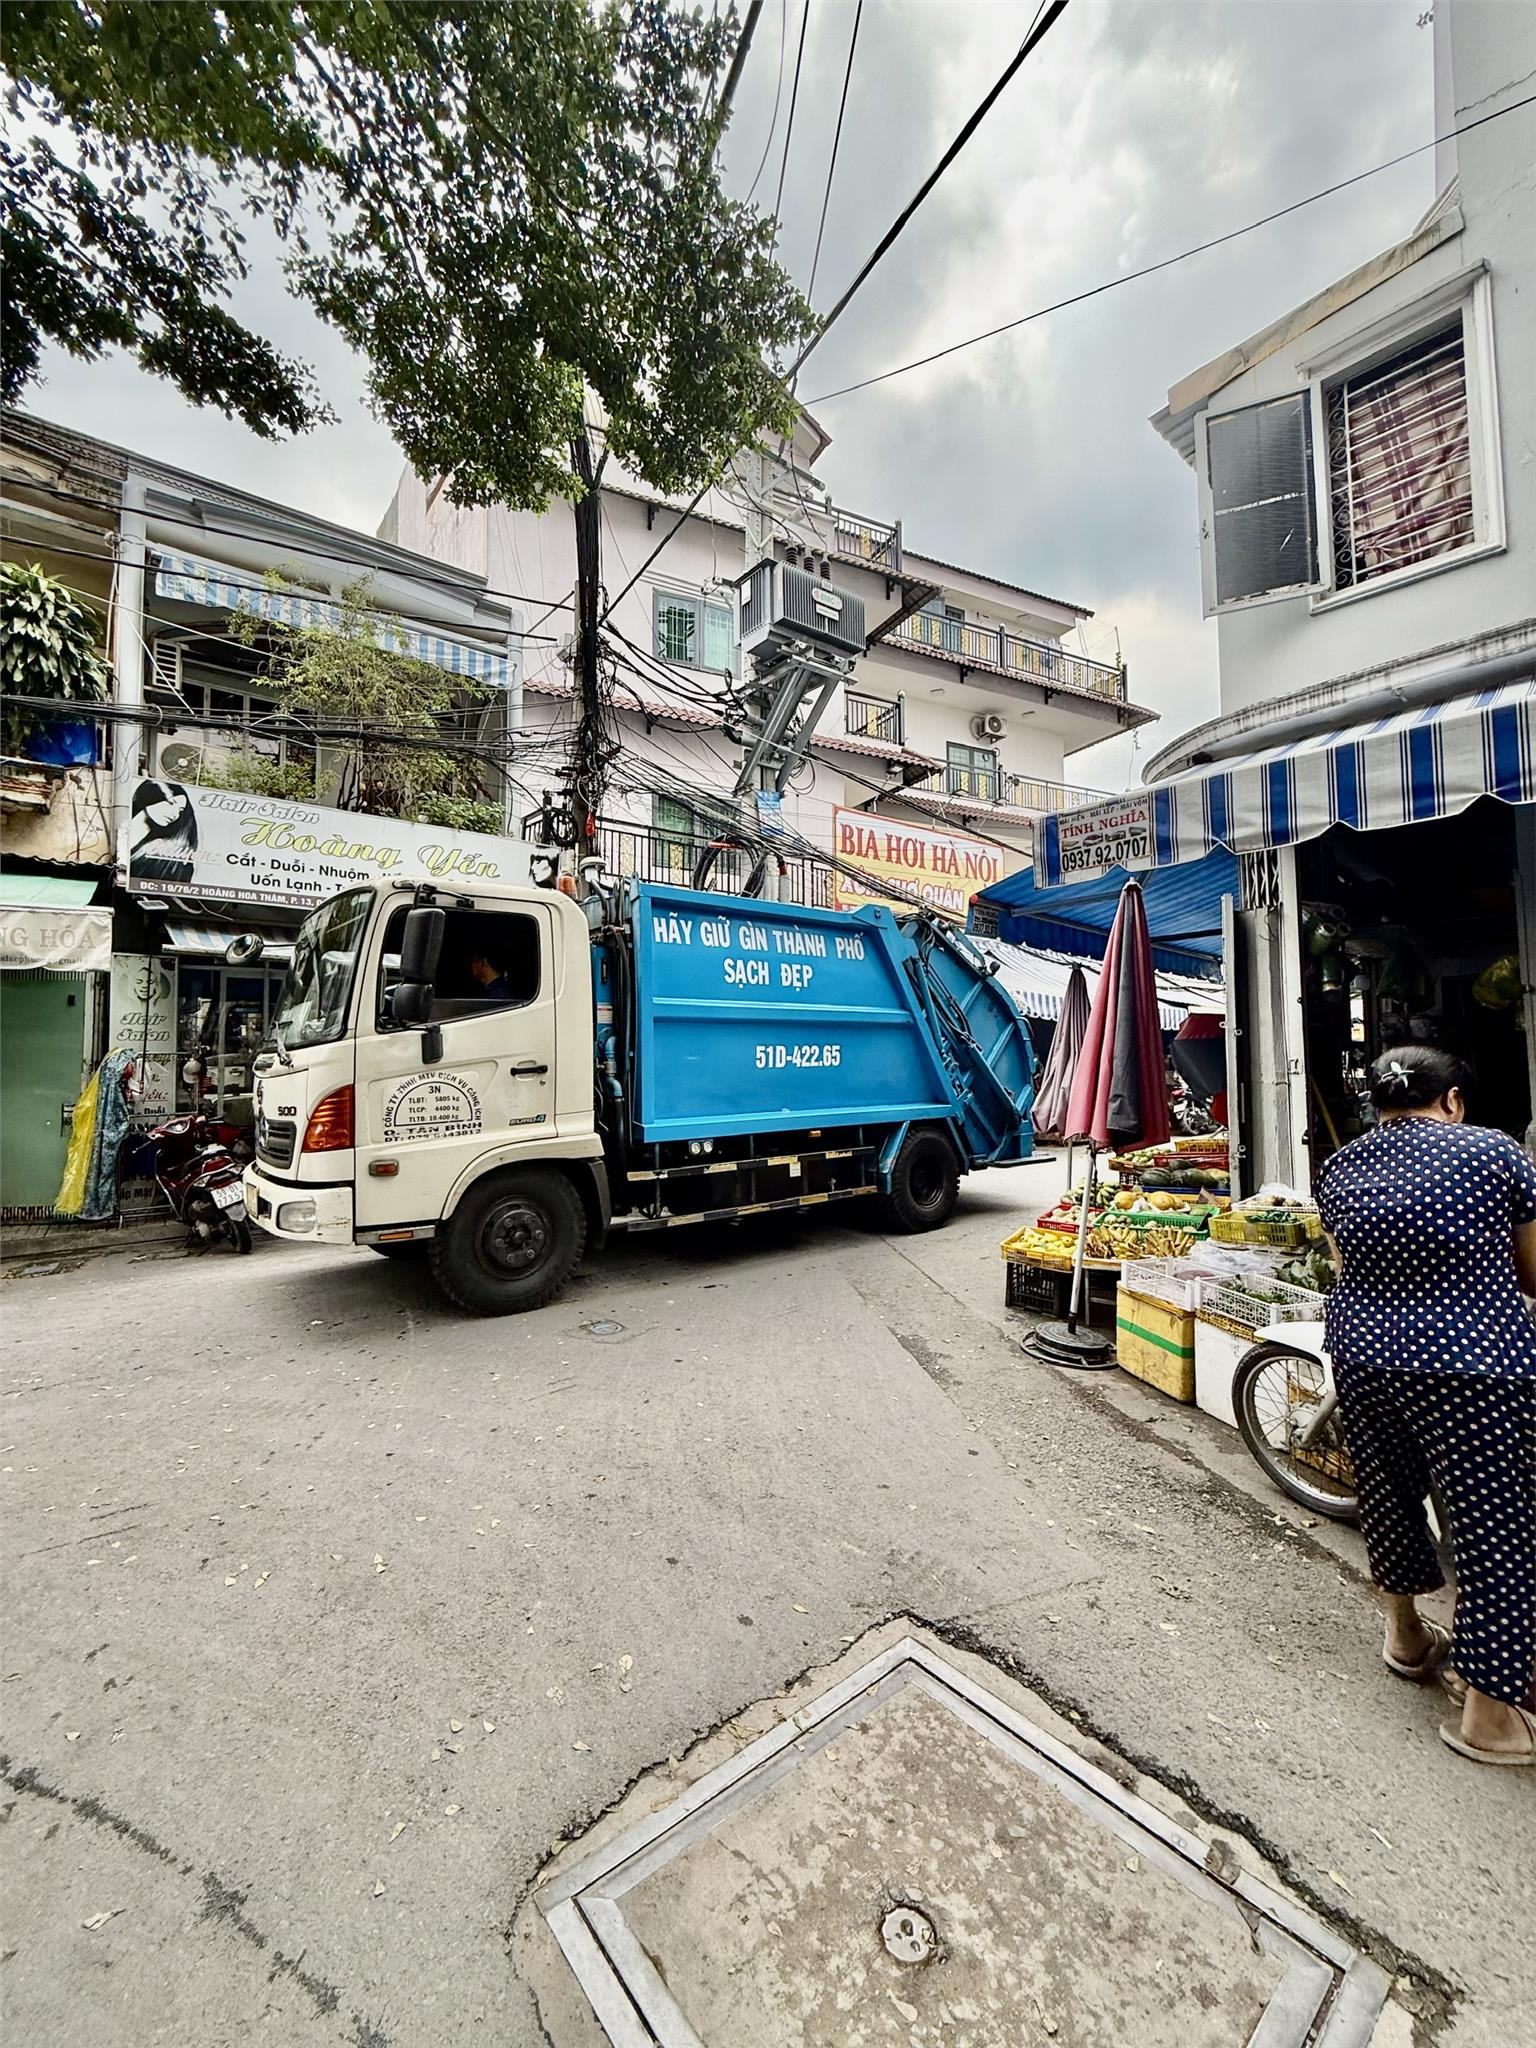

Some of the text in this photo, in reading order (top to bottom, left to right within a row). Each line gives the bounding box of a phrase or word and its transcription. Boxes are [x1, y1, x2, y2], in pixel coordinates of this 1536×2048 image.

[199, 793, 320, 825] Hair Salon
[1099, 808, 1148, 831] NGHĨA
[240, 817, 501, 879] Hoàng Yến
[839, 822, 999, 887] BIA HƠI HÀ NỘI
[1061, 835, 1148, 872] 0937.92.0707
[225, 852, 370, 883] Cắt Duỗi Nhuộm
[161, 882, 200, 896] 19/76/2
[201, 884, 236, 900] HOÀNG
[237, 890, 258, 902] HOA
[290, 896, 300, 906] P.
[250, 872, 281, 888] Uốn
[286, 877, 323, 894] Lạnh
[921, 881, 965, 912] QUÁN
[39, 923, 96, 950] HÓA
[652, 911, 866, 961] HÃY GIỮ GÌN THÀNH PHỐ
[723, 957, 814, 992] SẠCH ĐẸP
[120, 1012, 168, 1026] Hair
[116, 1027, 170, 1042] Salon
[754, 1044, 842, 1069] 51D-422.65
[388, 1093, 400, 1105] TY
[418, 1072, 436, 1081] MTV
[428, 1084, 441, 1095] 3N
[277, 1105, 297, 1117] 500
